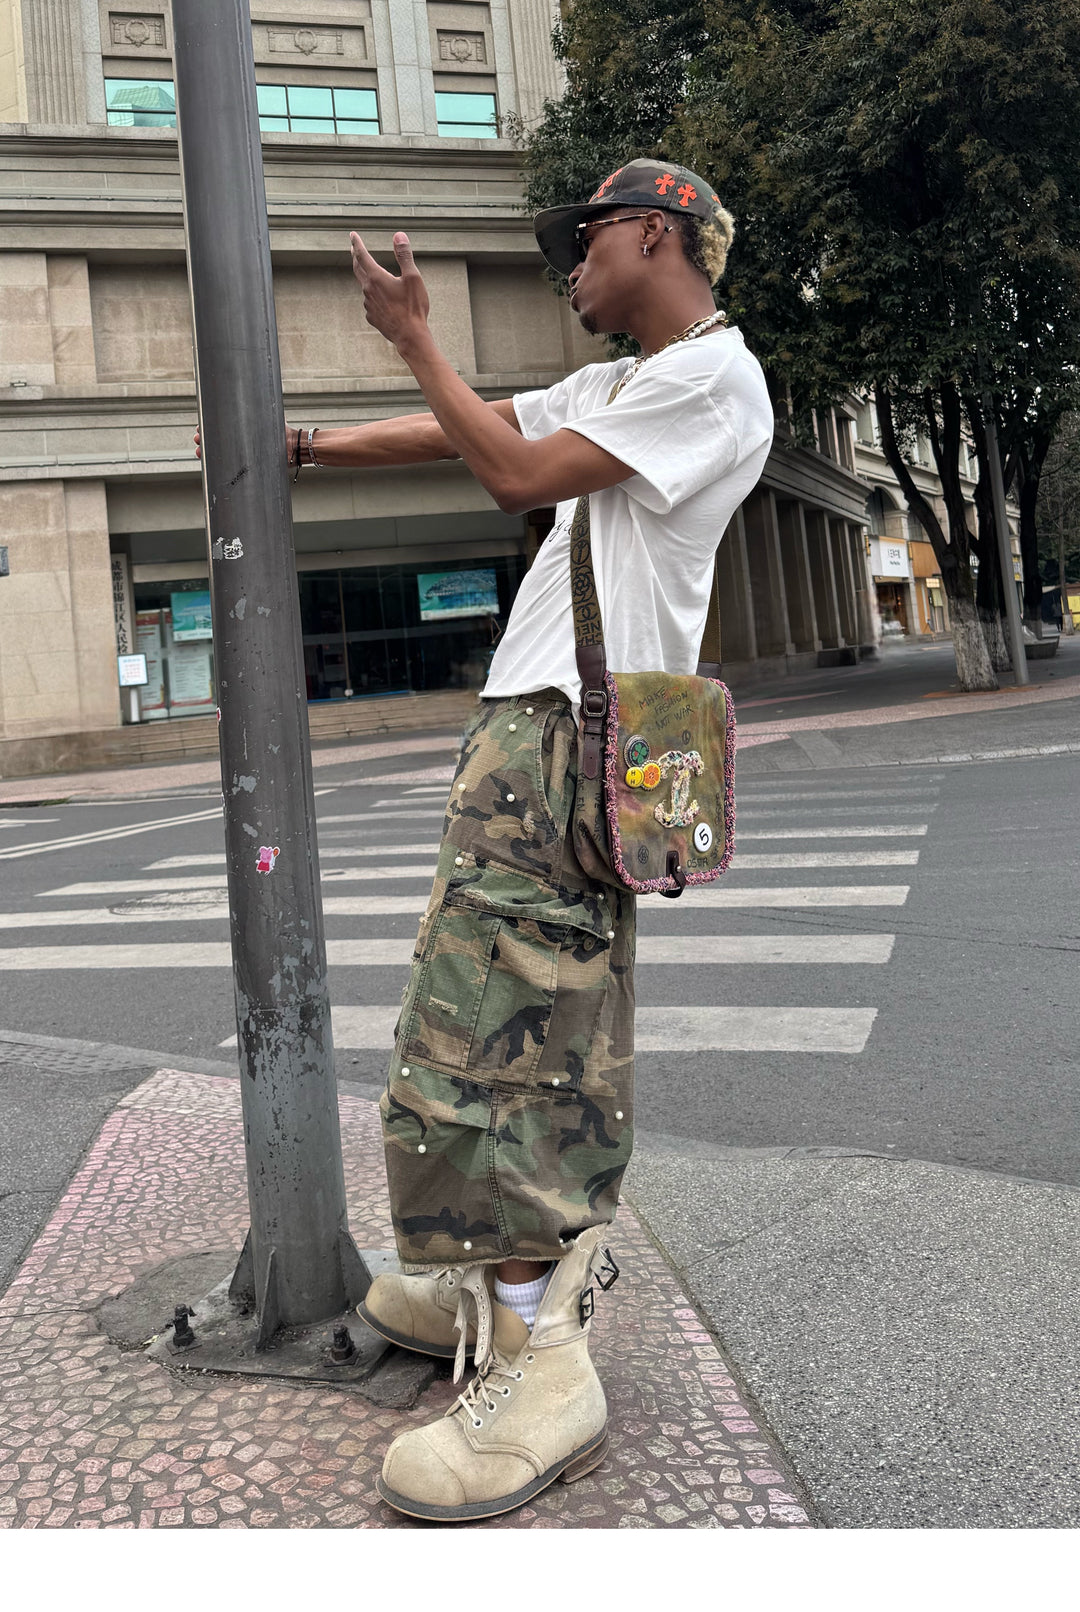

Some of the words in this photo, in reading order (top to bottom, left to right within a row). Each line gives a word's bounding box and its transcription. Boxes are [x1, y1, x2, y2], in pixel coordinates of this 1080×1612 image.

[638, 686, 666, 710] MAKE
[655, 715, 671, 731] NOT
[674, 704, 694, 721] WAR
[699, 828, 709, 846] 5
